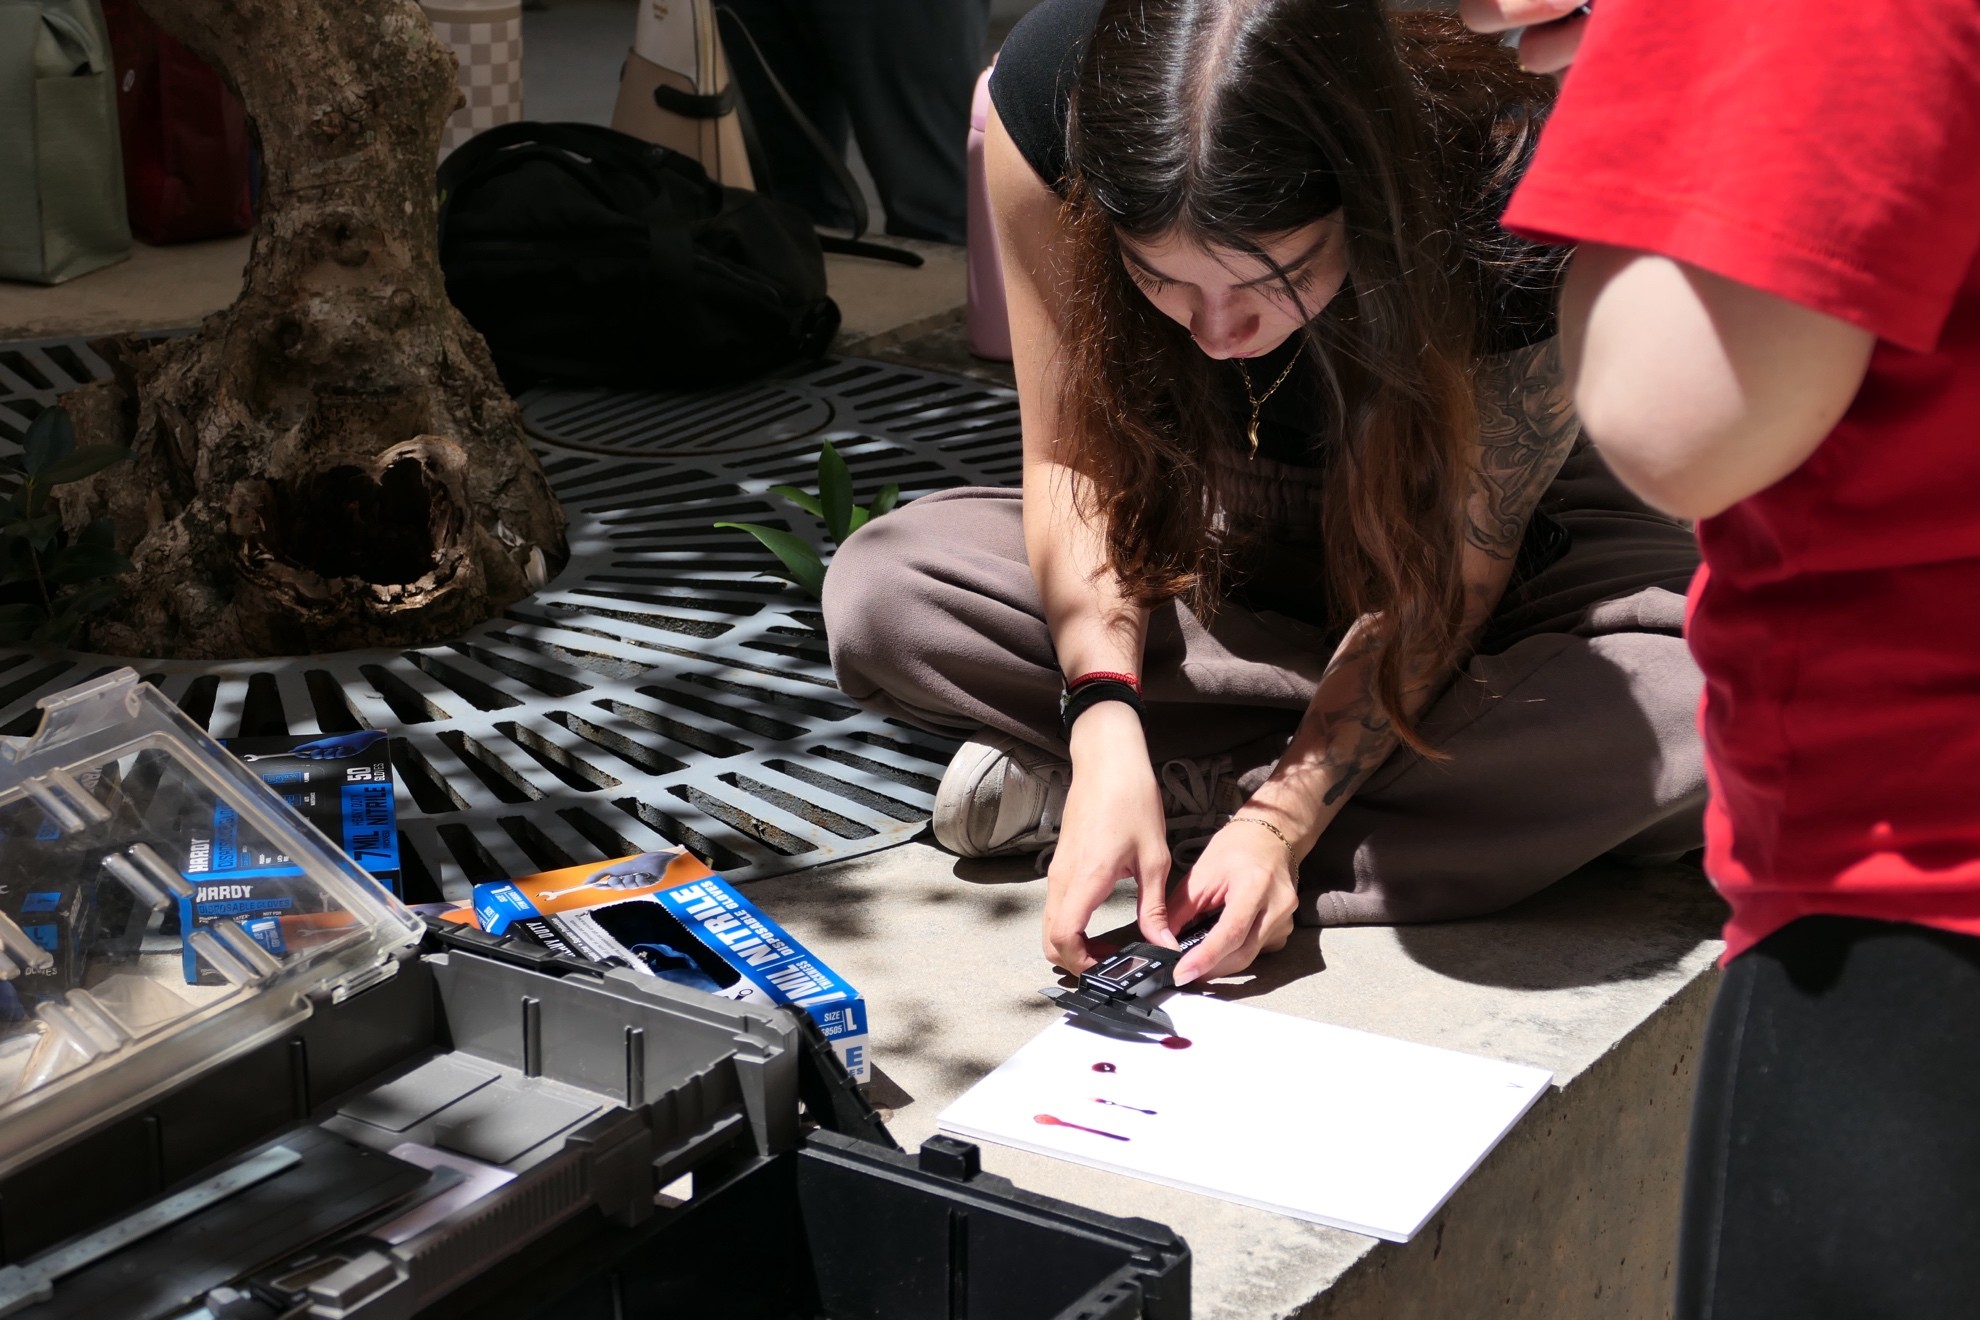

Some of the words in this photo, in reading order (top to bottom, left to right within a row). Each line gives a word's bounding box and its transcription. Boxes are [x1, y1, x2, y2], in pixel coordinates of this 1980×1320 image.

[347, 766, 372, 781] 50
[373, 763, 385, 781] GLOVES
[350, 794, 363, 809] DUTY
[364, 787, 388, 826] NITRILE
[352, 810, 364, 826] HEAVY
[352, 830, 380, 850] MIL
[188, 838, 210, 873] HARDY
[354, 850, 391, 862] 7
[196, 885, 252, 903] HARDY
[701, 880, 737, 910] GLOVES
[199, 901, 255, 914] DISPOSABLE
[256, 899, 290, 909] GLOVES
[526, 922, 554, 940] DUTY
[669, 884, 780, 967] NITRILE
[734, 909, 795, 957] DISPOSABLE
[766, 964, 822, 1000] MIL
[796, 960, 835, 990] THICKNESS
[824, 1010, 841, 1022] SIZE
